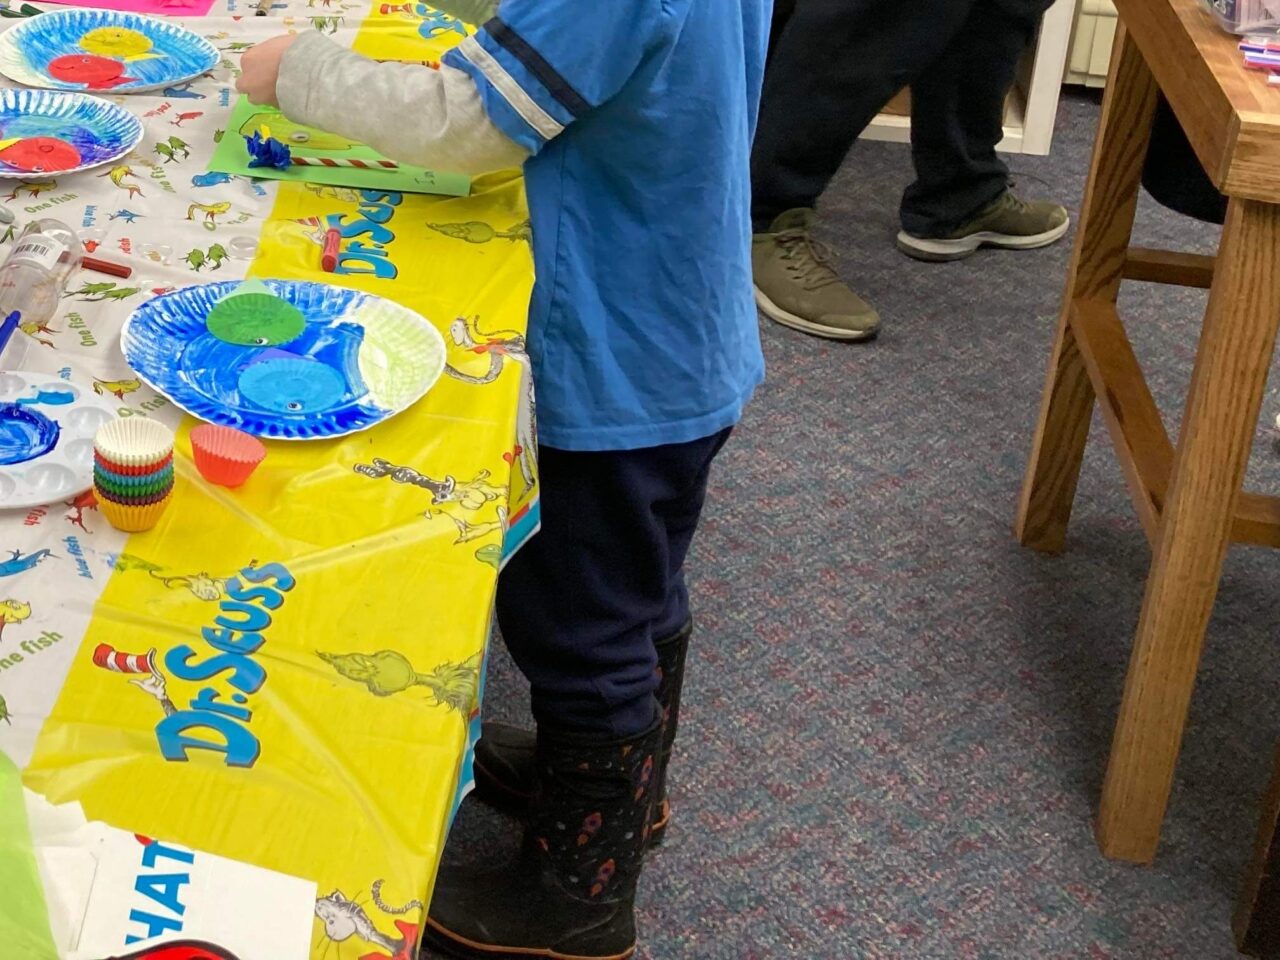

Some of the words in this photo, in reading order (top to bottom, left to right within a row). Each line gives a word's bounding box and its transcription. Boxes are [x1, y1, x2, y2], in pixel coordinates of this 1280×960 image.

[24, 200, 50, 214] One
[50, 192, 79, 209] fish
[68, 311, 87, 332] fish
[79, 330, 98, 347] One
[61, 536, 84, 560] fish
[72, 559, 94, 580] blue
[164, 561, 297, 695] Seuss
[20, 629, 64, 655] fish
[154, 686, 262, 769] Dr.
[125, 839, 196, 946] HAT
